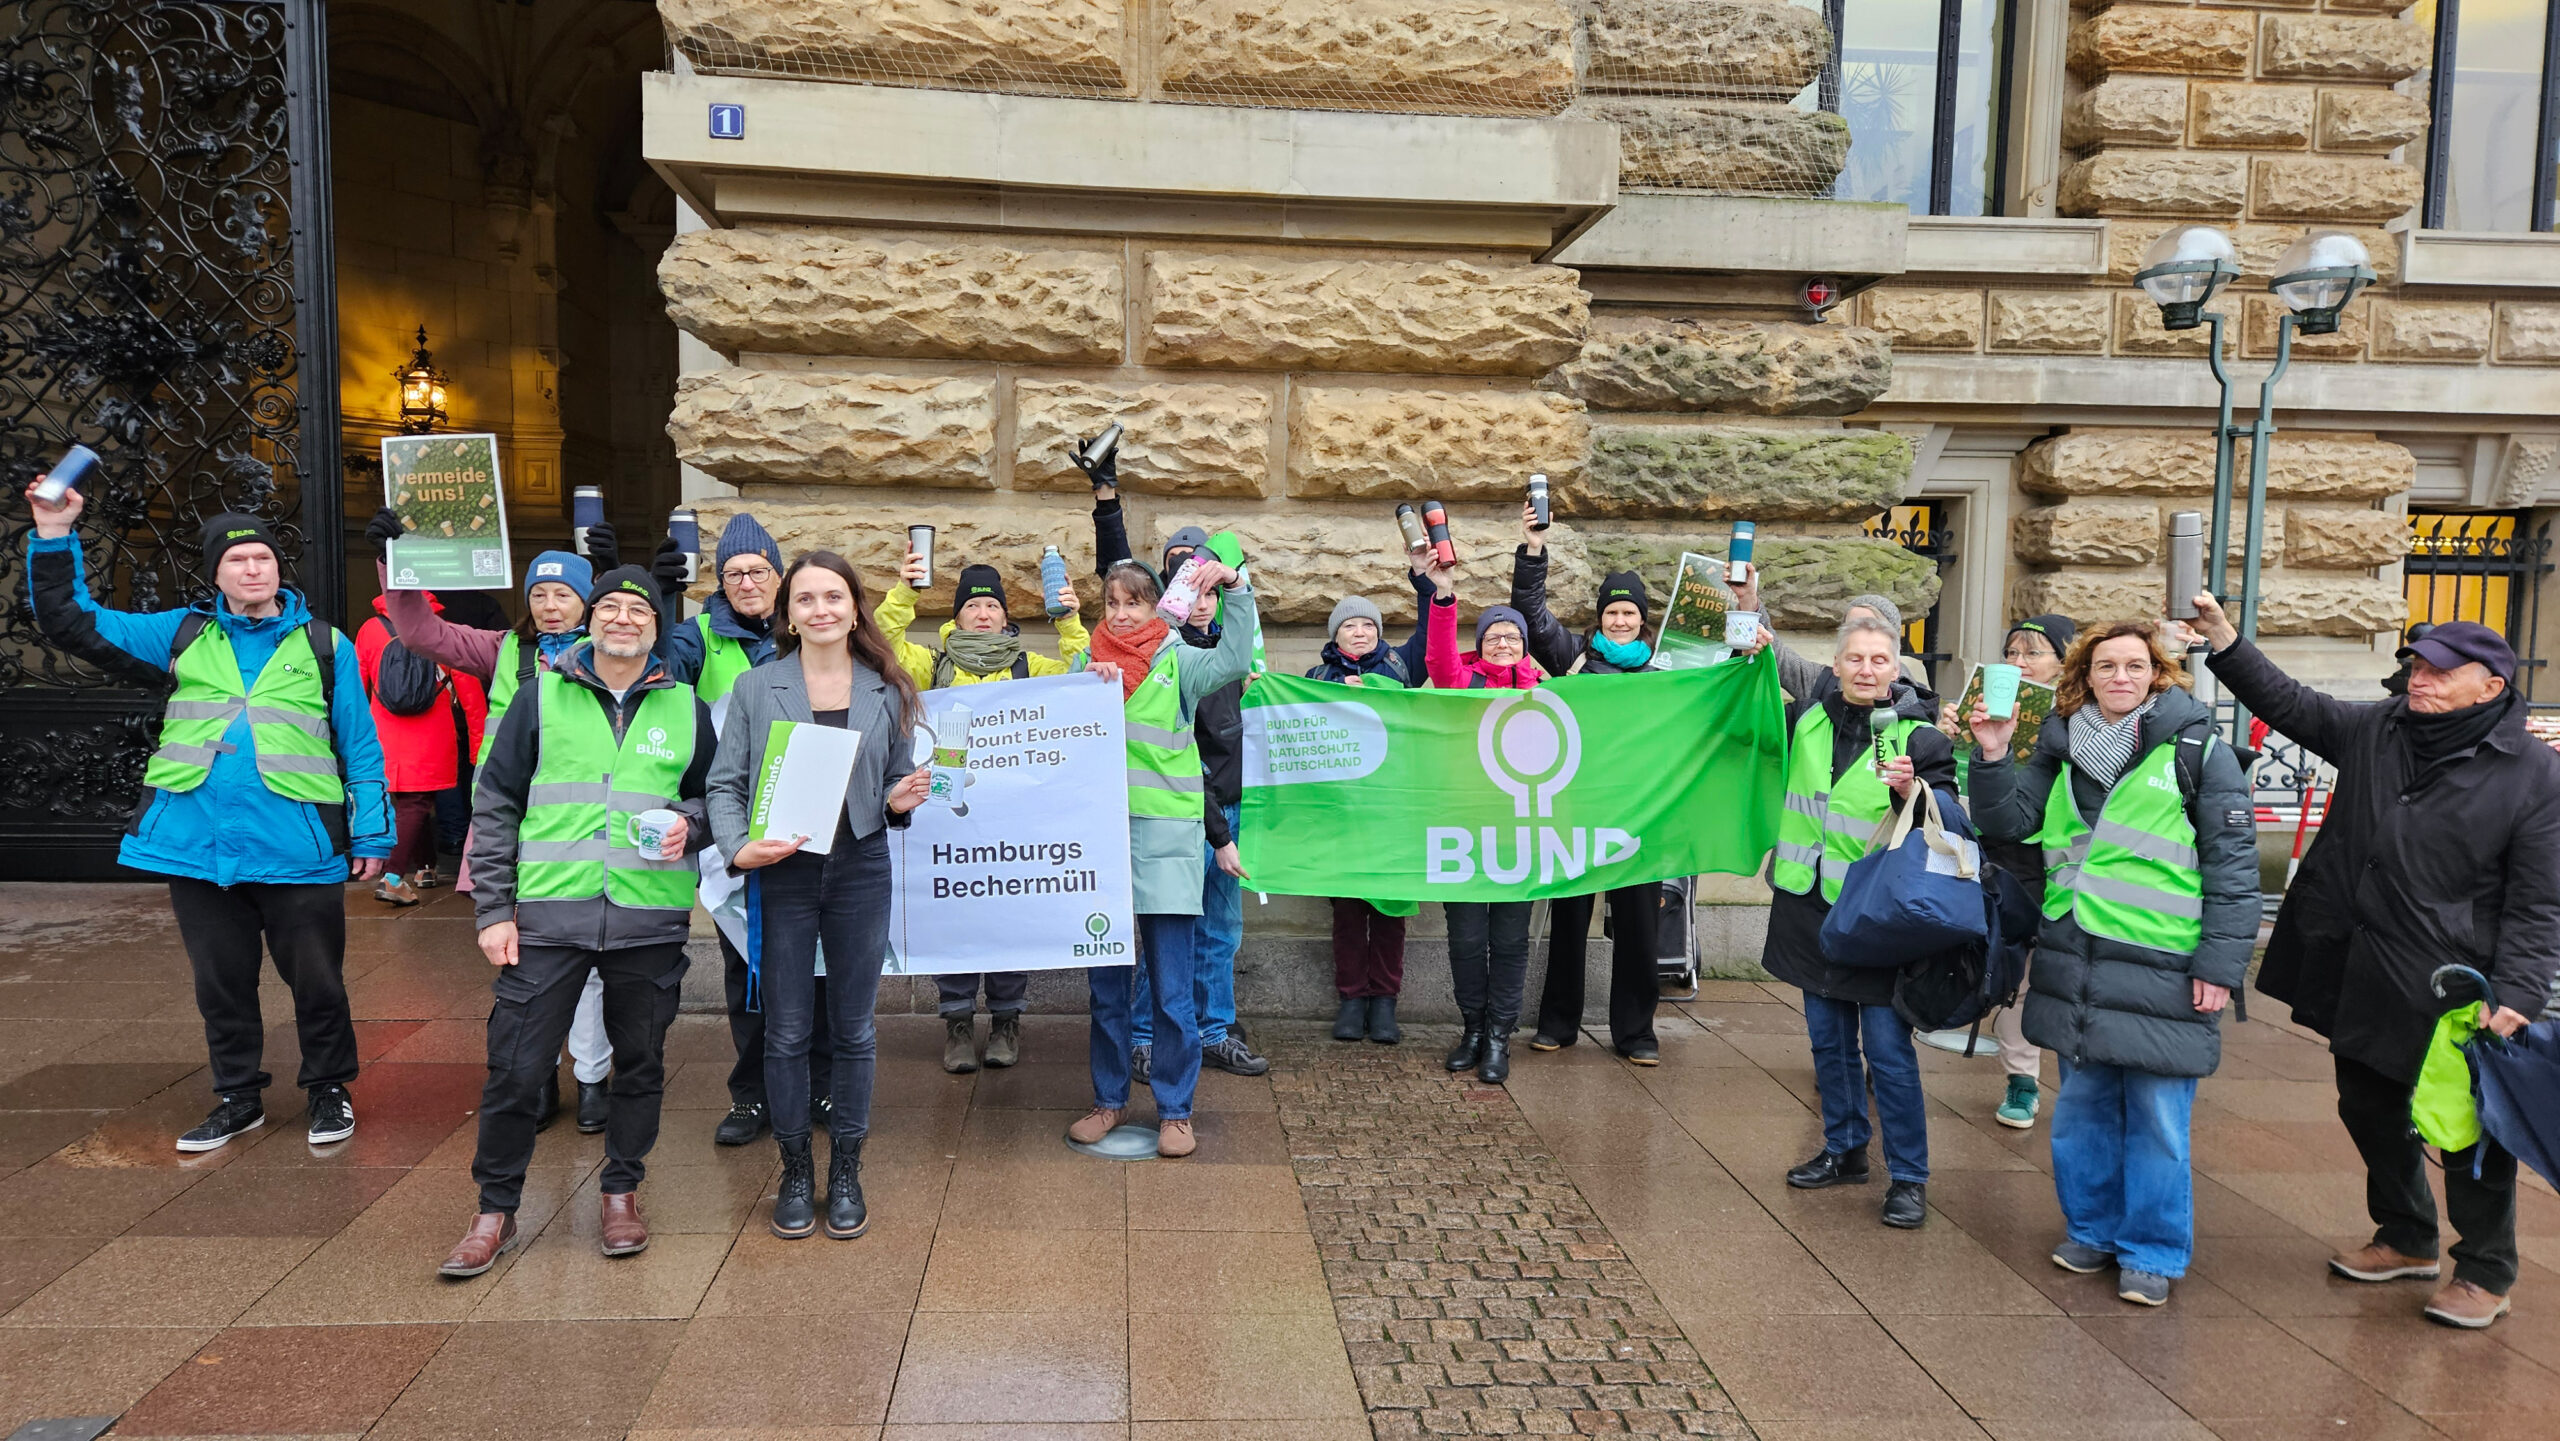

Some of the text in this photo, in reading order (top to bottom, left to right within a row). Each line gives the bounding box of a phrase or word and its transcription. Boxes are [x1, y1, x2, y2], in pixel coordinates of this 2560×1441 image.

[717, 109, 732, 133] 1
[395, 467, 486, 485] vermeide
[417, 485, 466, 502] uns!
[291, 667, 313, 678] BUND
[970, 706, 1045, 729] wei Mal
[1266, 714, 1328, 731] BUND FÜR
[1027, 721, 1108, 743] Everest.
[1267, 728, 1349, 744] UMWELT UND
[636, 743, 675, 760] BUND
[967, 749, 1067, 770] eden Tag.
[1268, 742, 1361, 759] NATURSCHUTZ
[1269, 756, 1362, 774] DEUTSCHLAND
[755, 755, 783, 825] BUNDinfo
[2147, 775, 2181, 798] BUN
[932, 841, 1083, 866] Hamburgs
[1425, 826, 1642, 885] BUND
[933, 869, 1097, 899] Bechermüll
[1072, 942, 1126, 958] BUND
